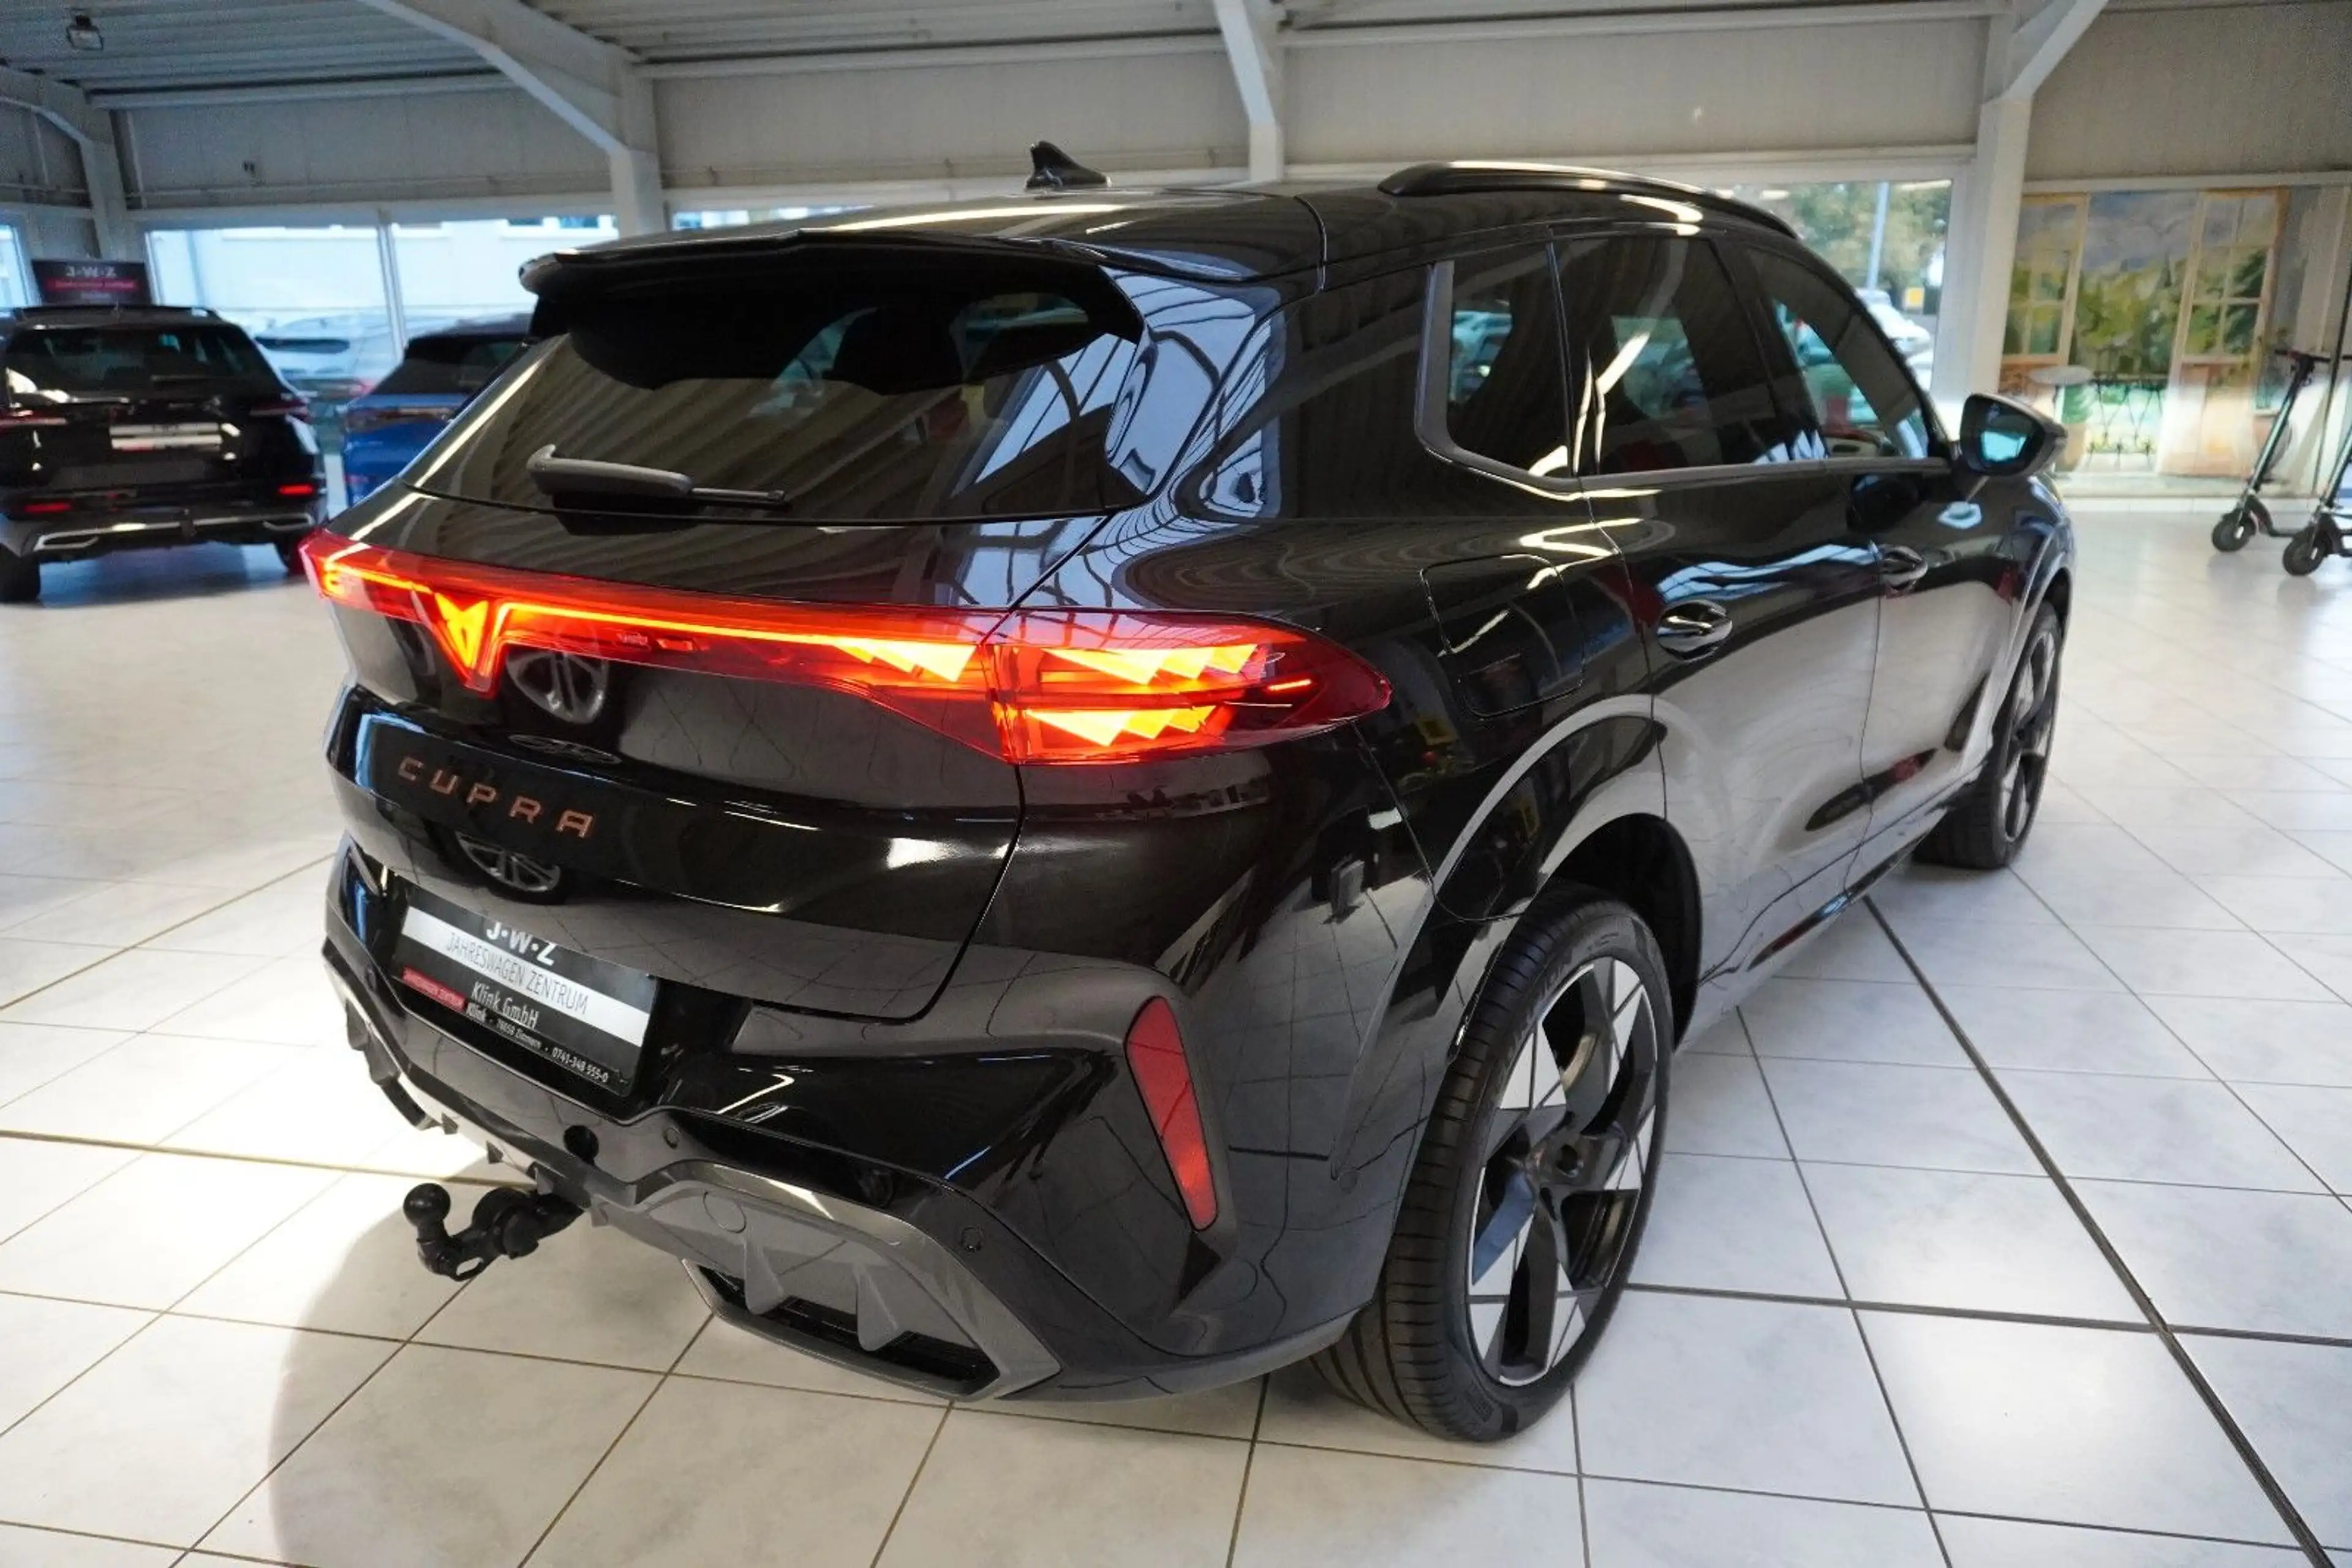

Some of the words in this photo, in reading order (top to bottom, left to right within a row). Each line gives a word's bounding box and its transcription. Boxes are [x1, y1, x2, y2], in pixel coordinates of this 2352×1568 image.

[398, 756, 595, 839] CUPRA
[446, 932, 526, 988] JAHRESWAGEN
[526, 971, 589, 1015] ZENTRUM
[470, 981, 501, 1011] Klink
[502, 997, 540, 1030] GmbH
